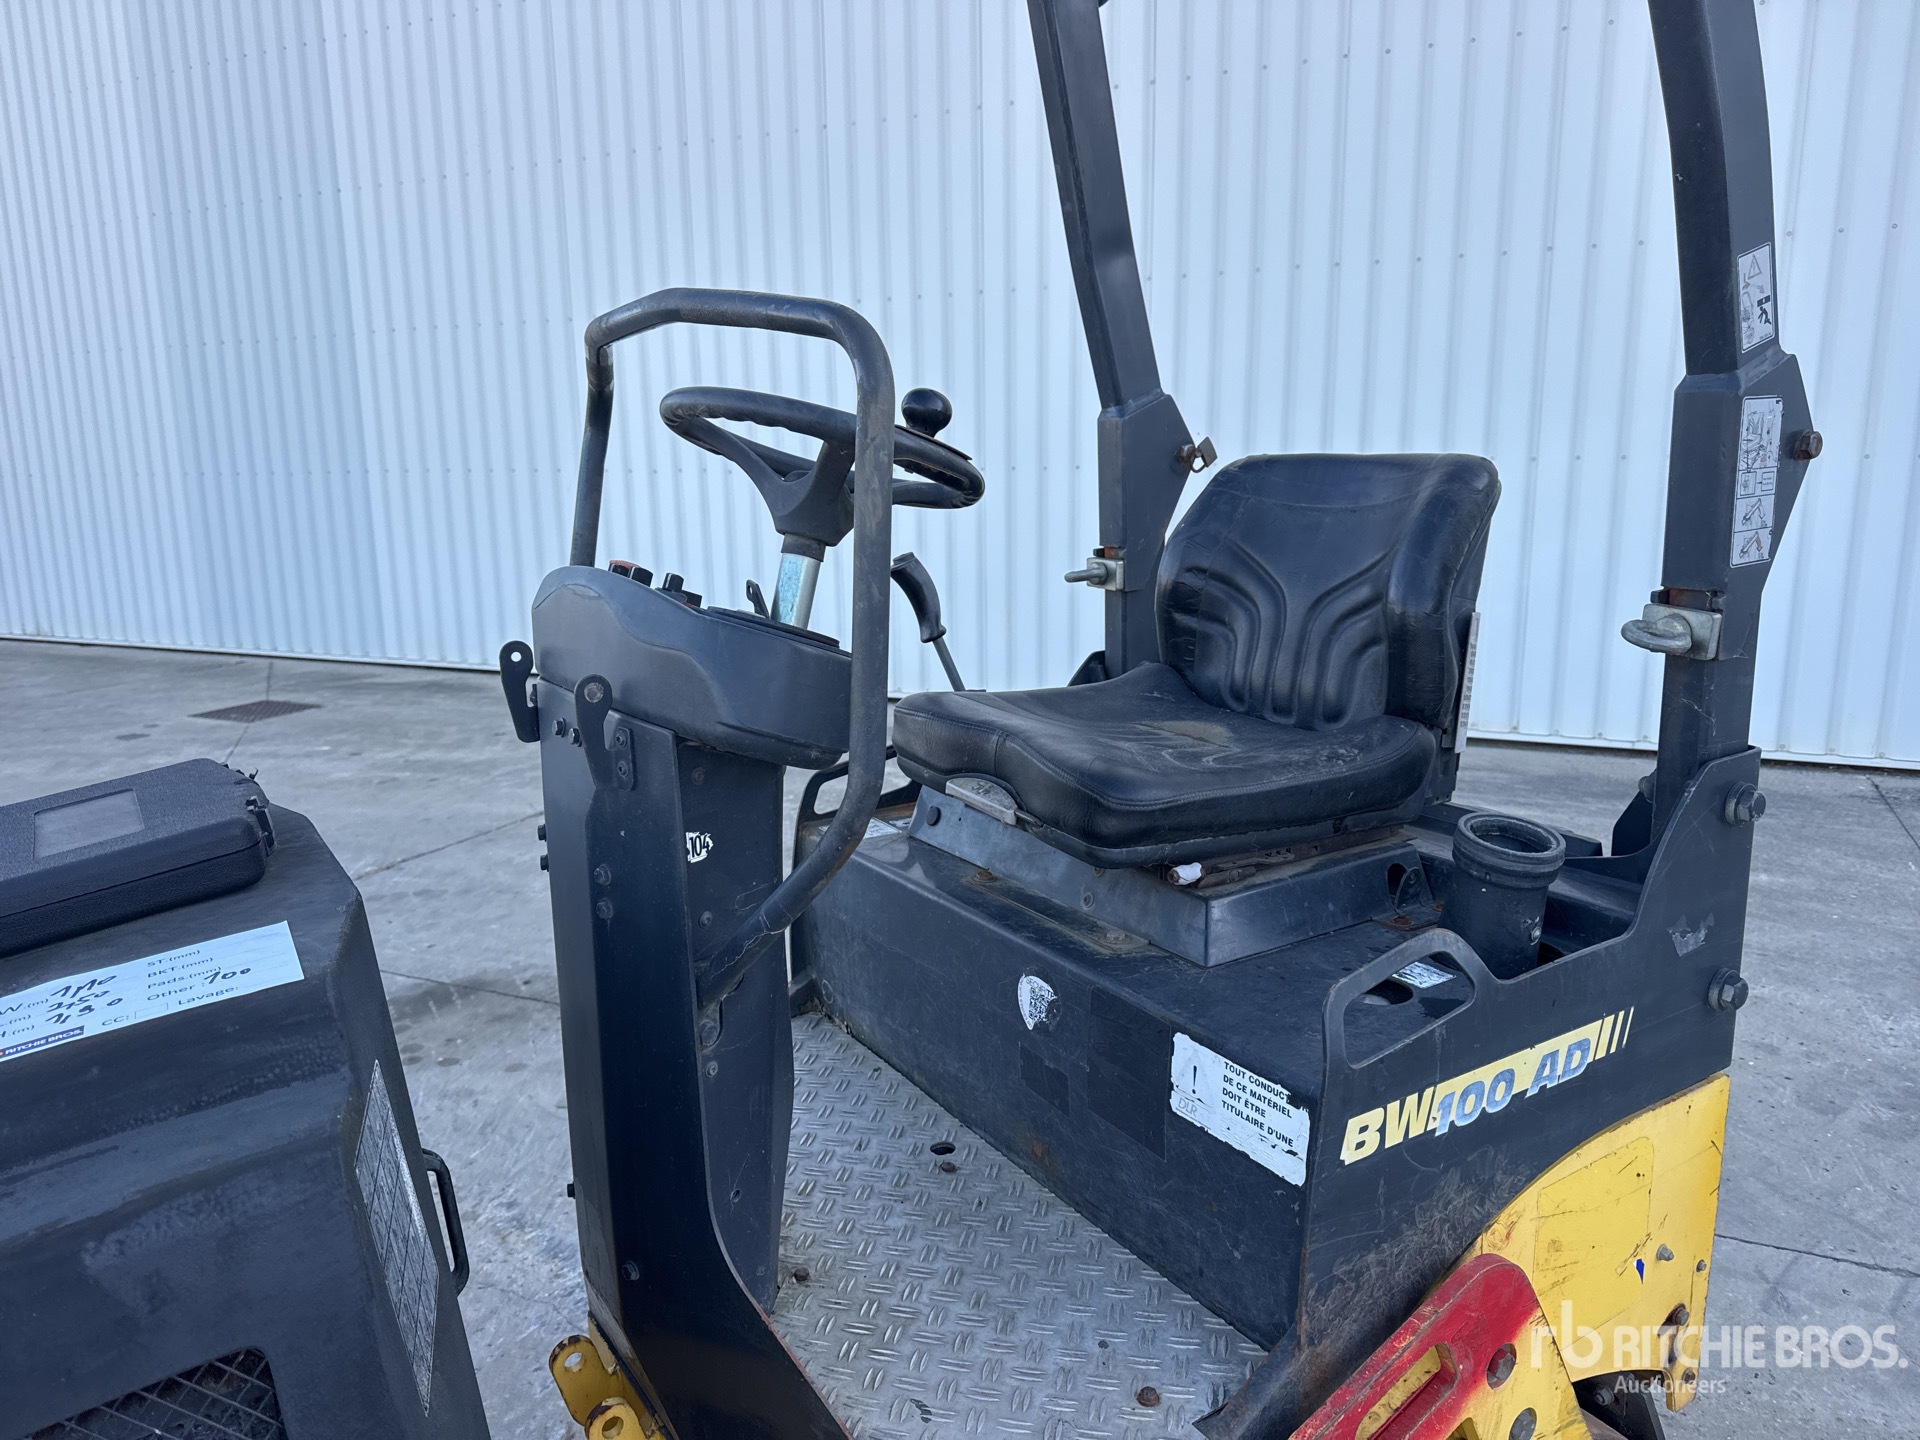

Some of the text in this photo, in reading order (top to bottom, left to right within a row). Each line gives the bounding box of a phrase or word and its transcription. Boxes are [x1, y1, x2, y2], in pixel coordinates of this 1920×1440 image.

[689, 834, 710, 858] 104
[203, 967, 252, 985] 100
[147, 983, 196, 1001] Other
[102, 1015, 129, 1026] CC:
[5, 1036, 47, 1055] RITCHIE
[1224, 1061, 1247, 1079] TOUT
[1525, 1037, 1592, 1098] AD
[1222, 1087, 1266, 1118] DOIT ÊTRE
[1223, 1074, 1292, 1118] DE CE MATÉRIEL
[1221, 1100, 1265, 1131] TITULAIRE
[1267, 1126, 1294, 1147] D'UNE
